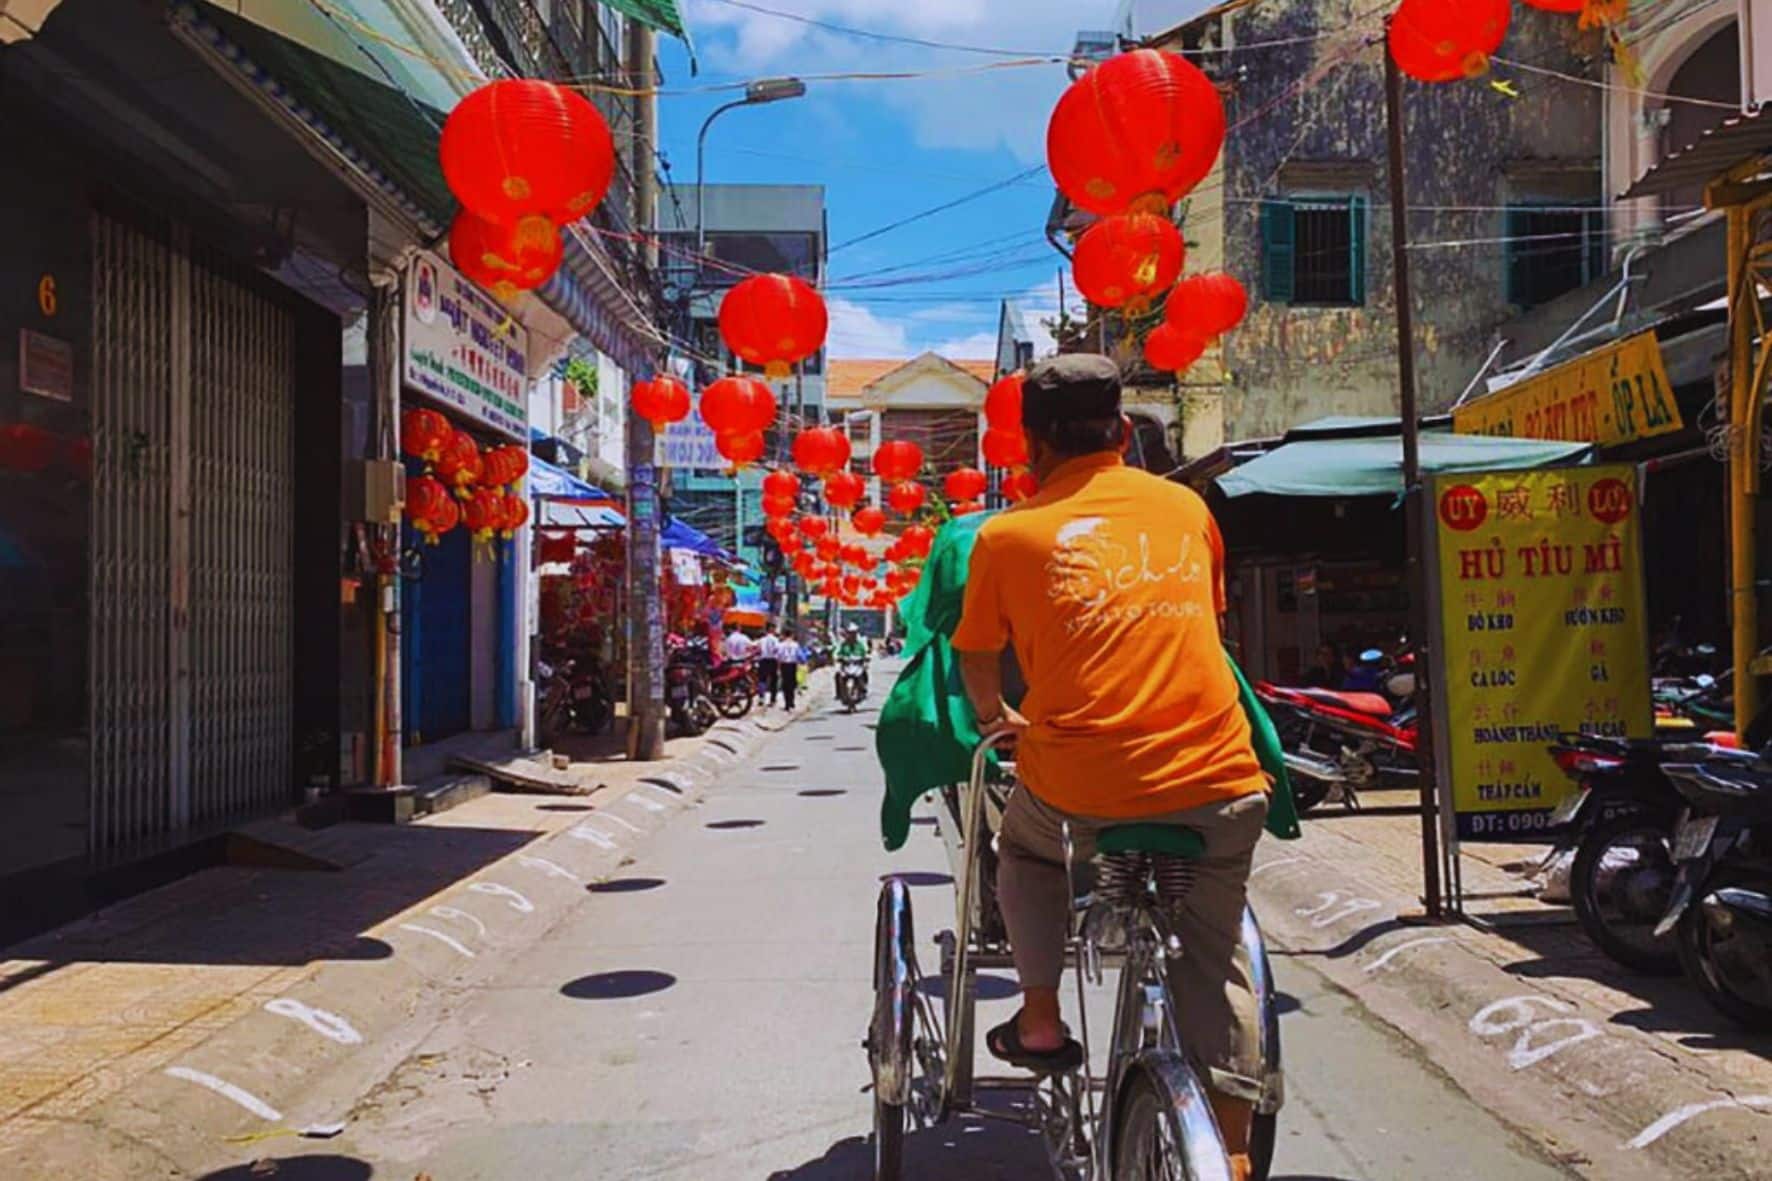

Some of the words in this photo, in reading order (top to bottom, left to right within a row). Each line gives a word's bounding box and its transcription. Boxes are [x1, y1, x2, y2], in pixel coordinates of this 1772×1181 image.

[39, 274, 57, 316] 6
[1459, 536, 1506, 580] HỦ
[1518, 538, 1573, 577] TÍU
[1584, 534, 1623, 574] MÌ
